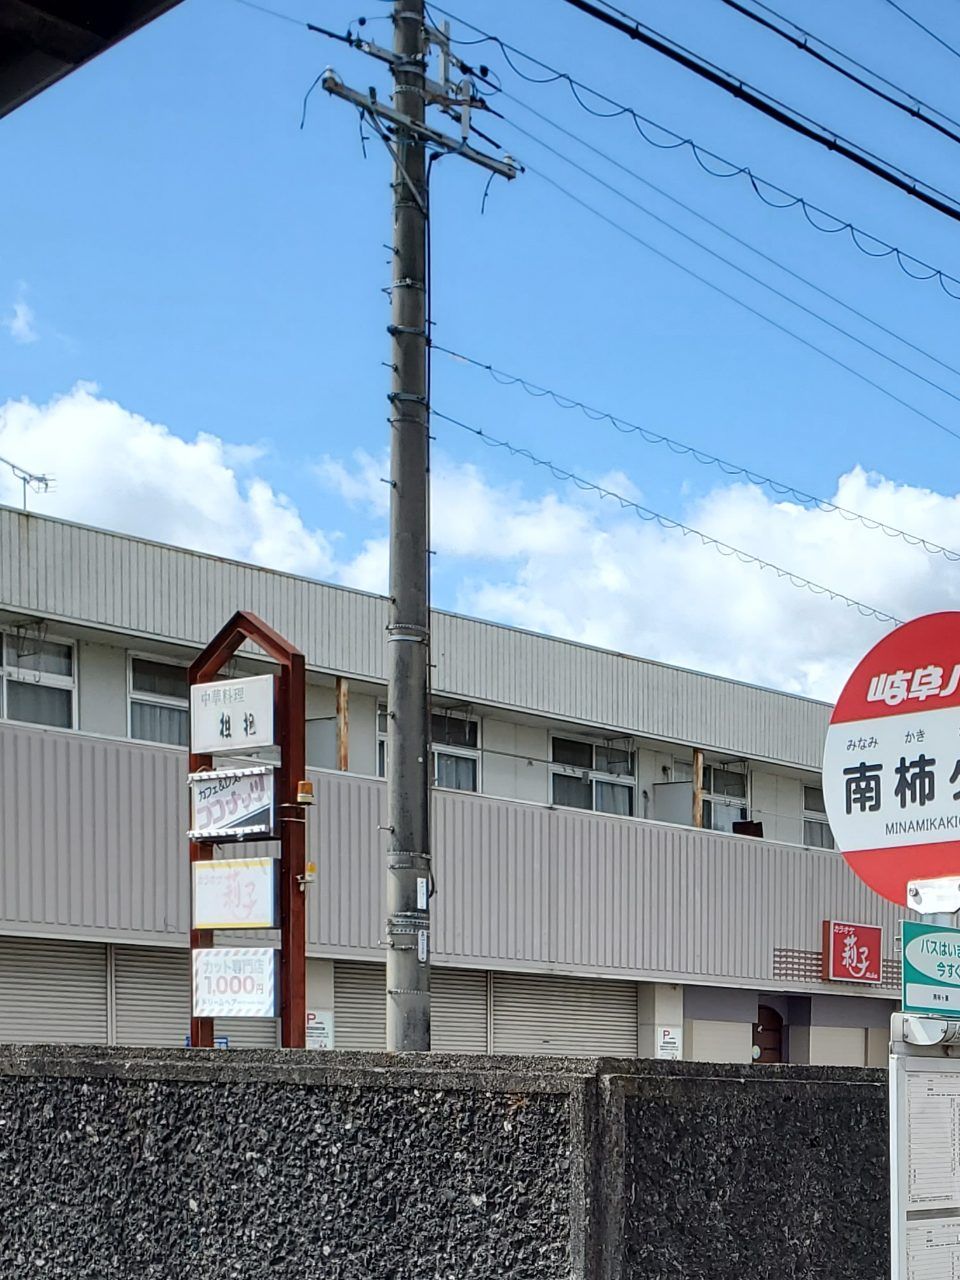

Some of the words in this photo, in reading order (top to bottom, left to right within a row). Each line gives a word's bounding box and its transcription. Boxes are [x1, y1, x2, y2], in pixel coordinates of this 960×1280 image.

[201, 687, 245, 707] 中華料理
[846, 737, 879, 751] みなみ
[904, 729, 926, 743] かき
[203, 959, 264, 975] カット専門店
[204, 975, 264, 996] 1,000円
[307, 1013, 317, 1025] P
[663, 1030, 670, 1040] P
